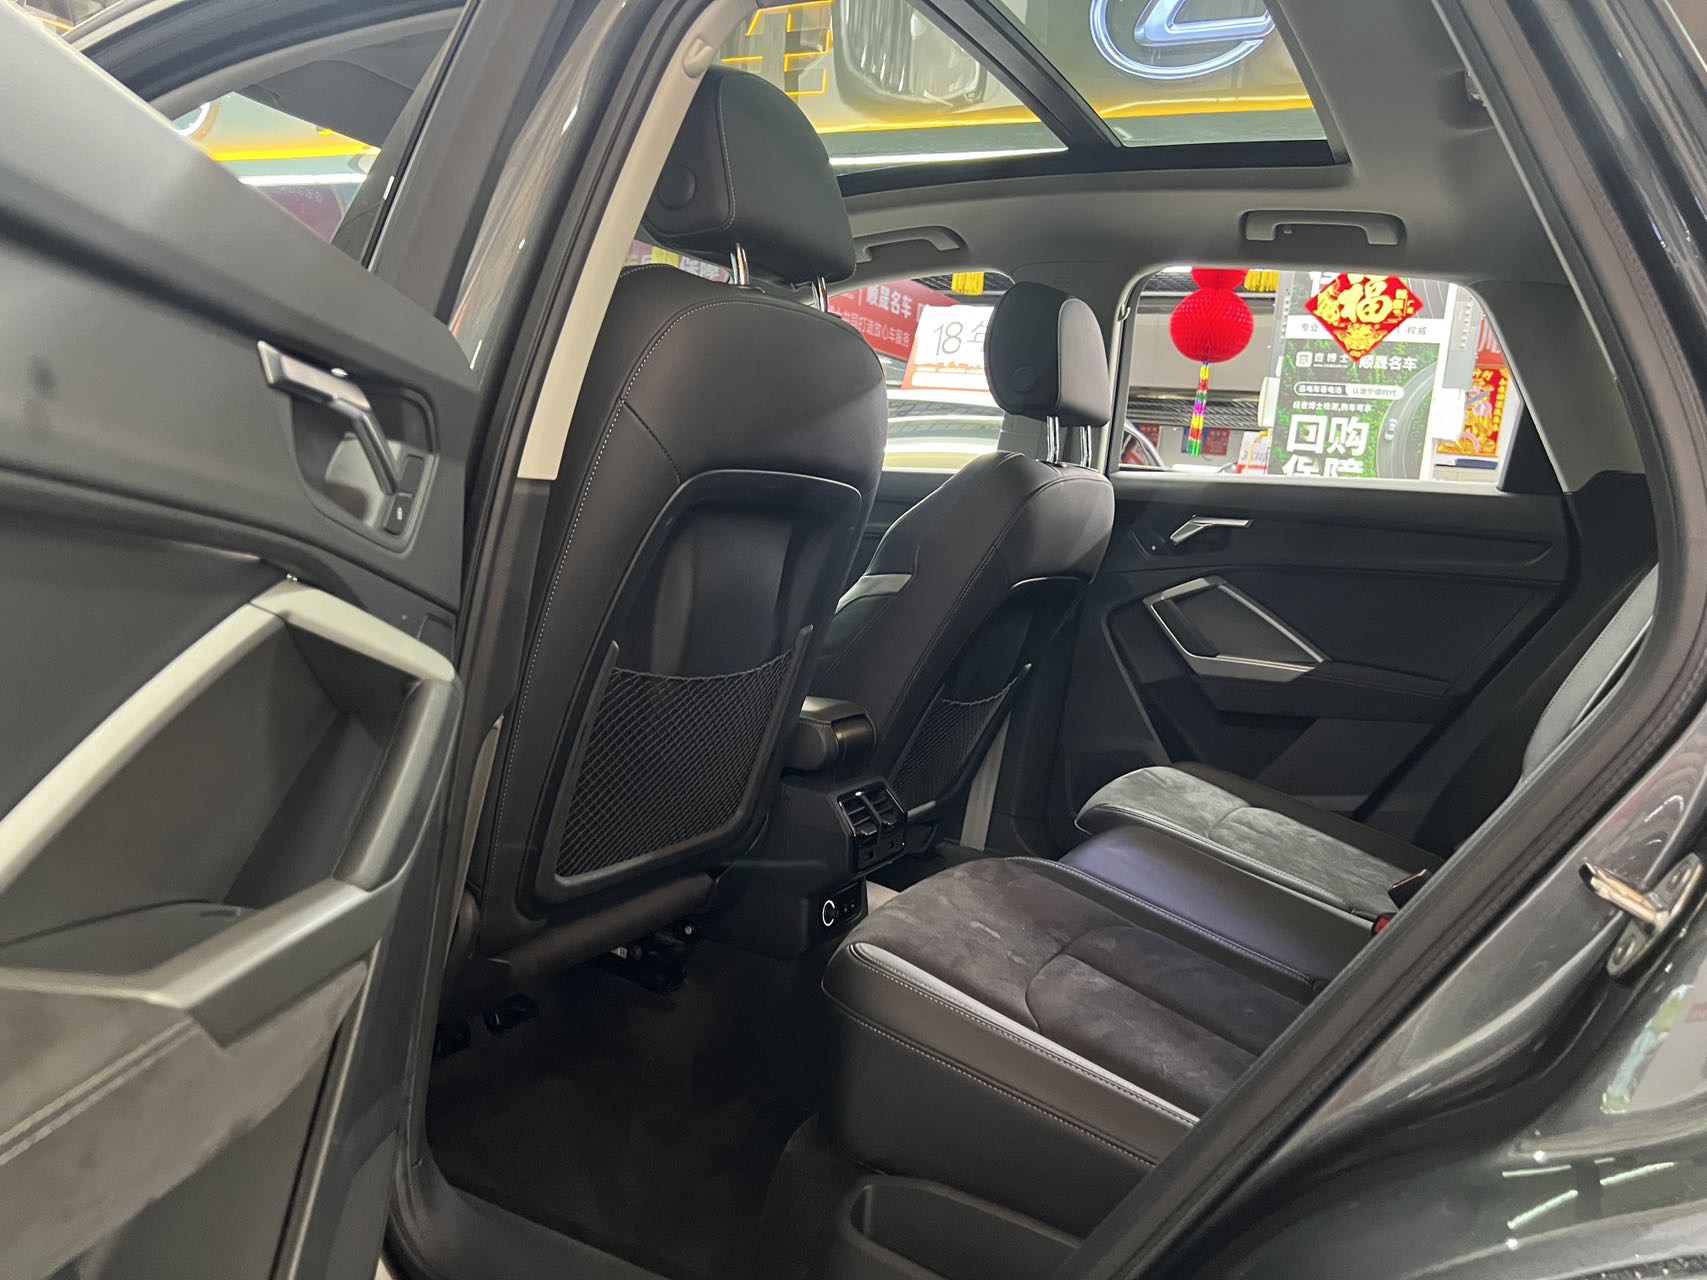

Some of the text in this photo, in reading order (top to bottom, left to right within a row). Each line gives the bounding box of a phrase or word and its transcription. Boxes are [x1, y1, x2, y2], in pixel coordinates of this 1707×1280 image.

[1337, 272, 1393, 323] 福
[1301, 323, 1428, 335] 专业 权威
[1287, 414, 1370, 456] 回购
